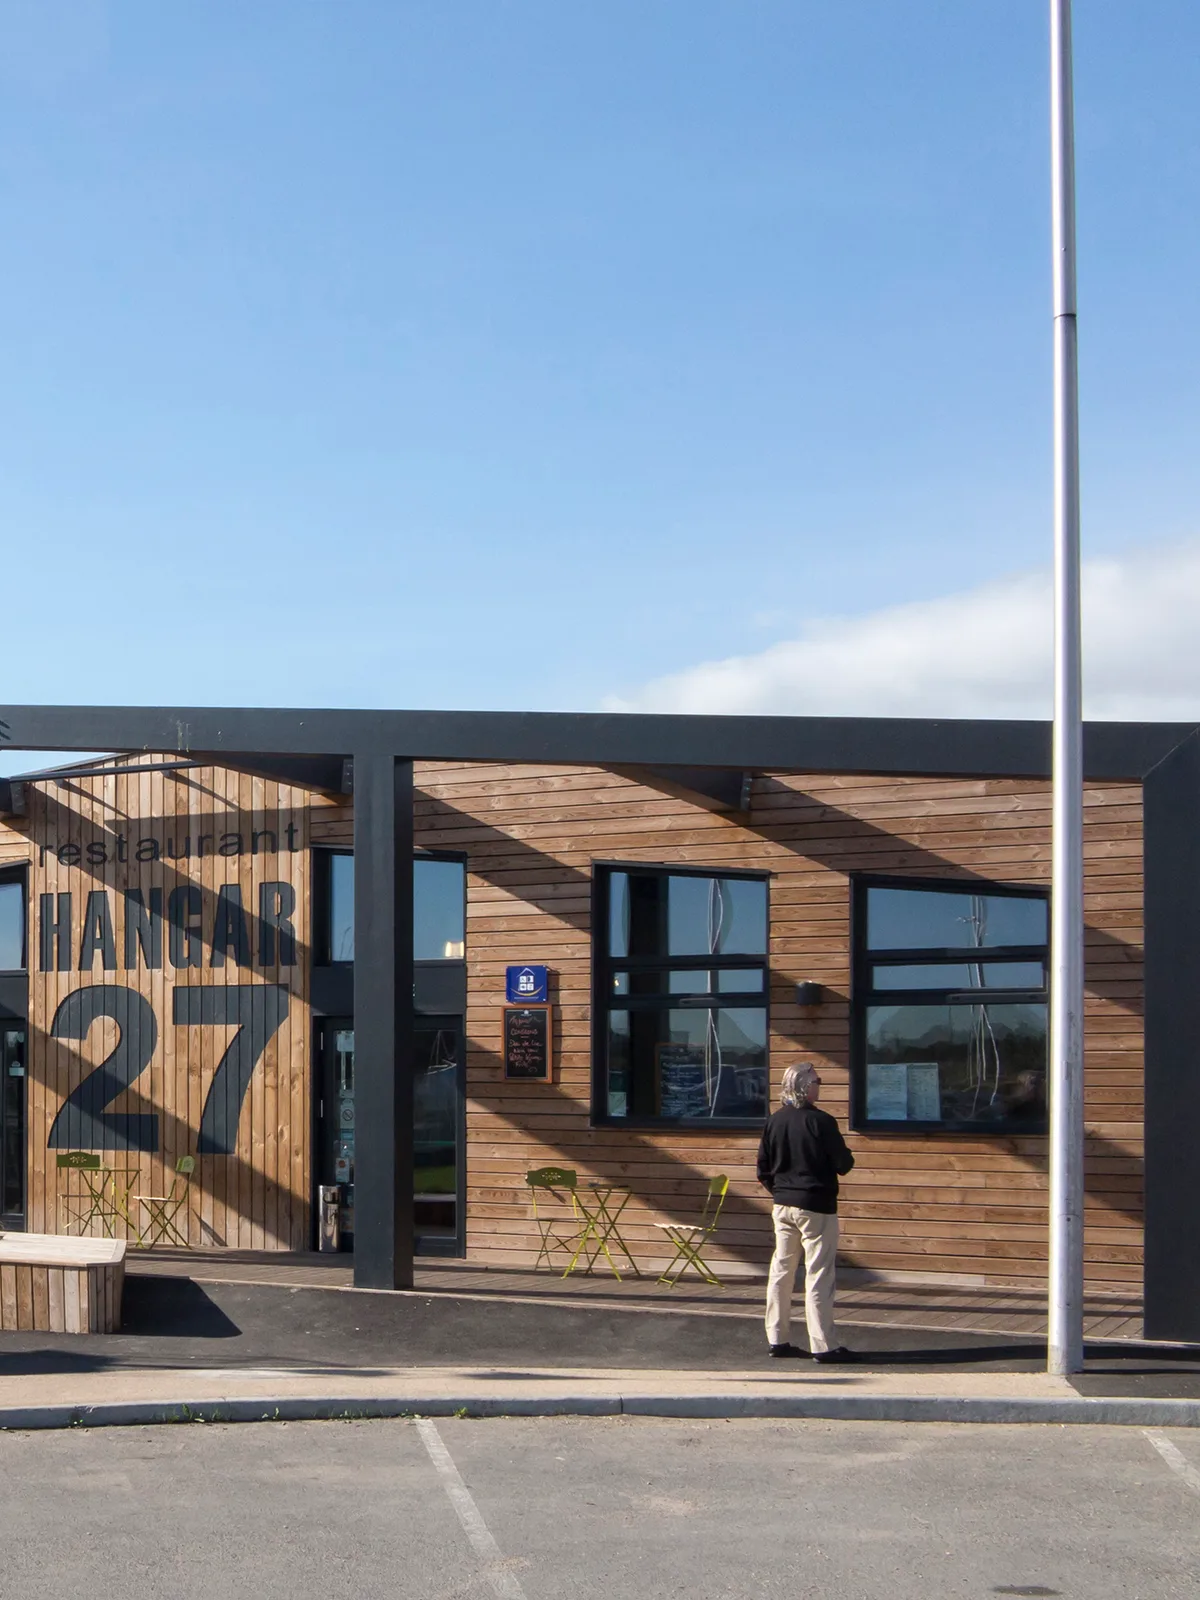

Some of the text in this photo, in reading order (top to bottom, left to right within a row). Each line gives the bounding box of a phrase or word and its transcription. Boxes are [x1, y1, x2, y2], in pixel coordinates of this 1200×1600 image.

[39, 821, 300, 868] restaurant
[39, 881, 297, 973] HANGAR
[47, 983, 290, 1155] 27
